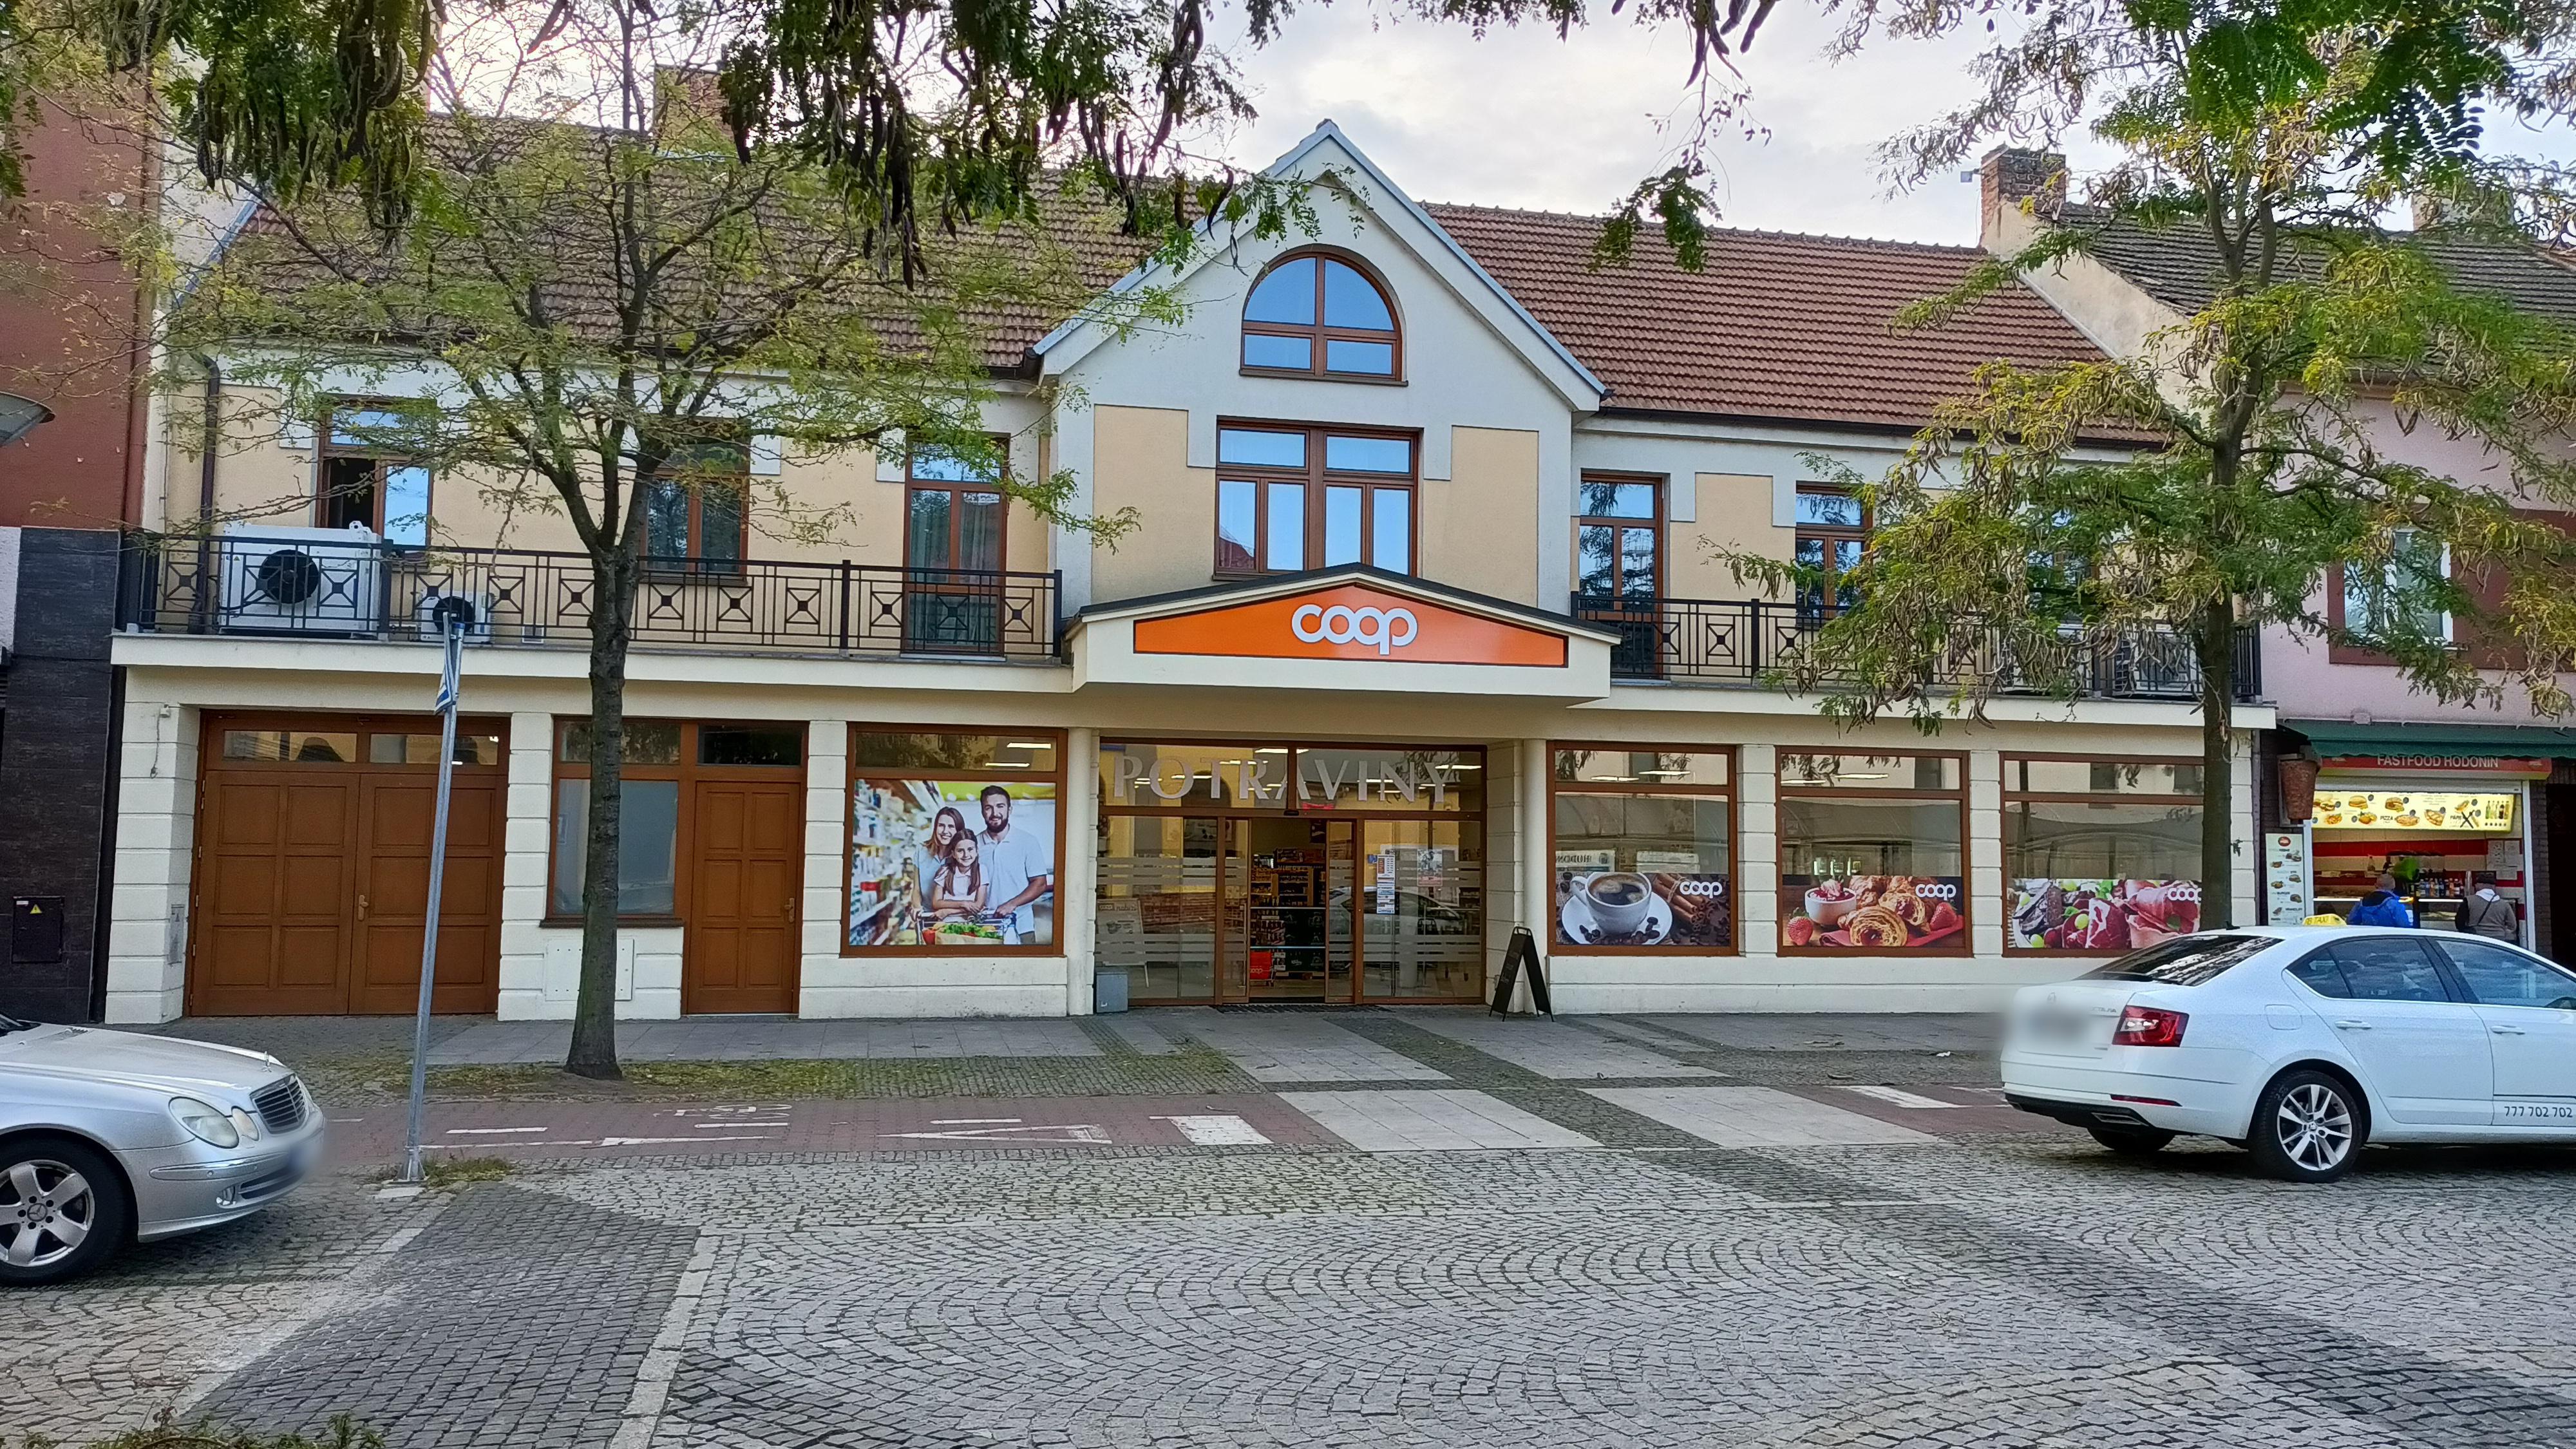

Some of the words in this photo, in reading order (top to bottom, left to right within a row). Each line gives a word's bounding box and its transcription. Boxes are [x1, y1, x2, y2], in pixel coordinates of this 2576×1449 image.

[1291, 604, 1418, 655] coop
[2377, 755, 2441, 766] FASTFOOD
[1113, 754, 1455, 803] POTRAVINY
[1680, 881, 1723, 899] coop
[1915, 884, 1956, 901] coop
[2504, 1106, 2524, 1117] 777
[2528, 1106, 2549, 1117] 702
[2552, 1107, 2573, 1118] 702
